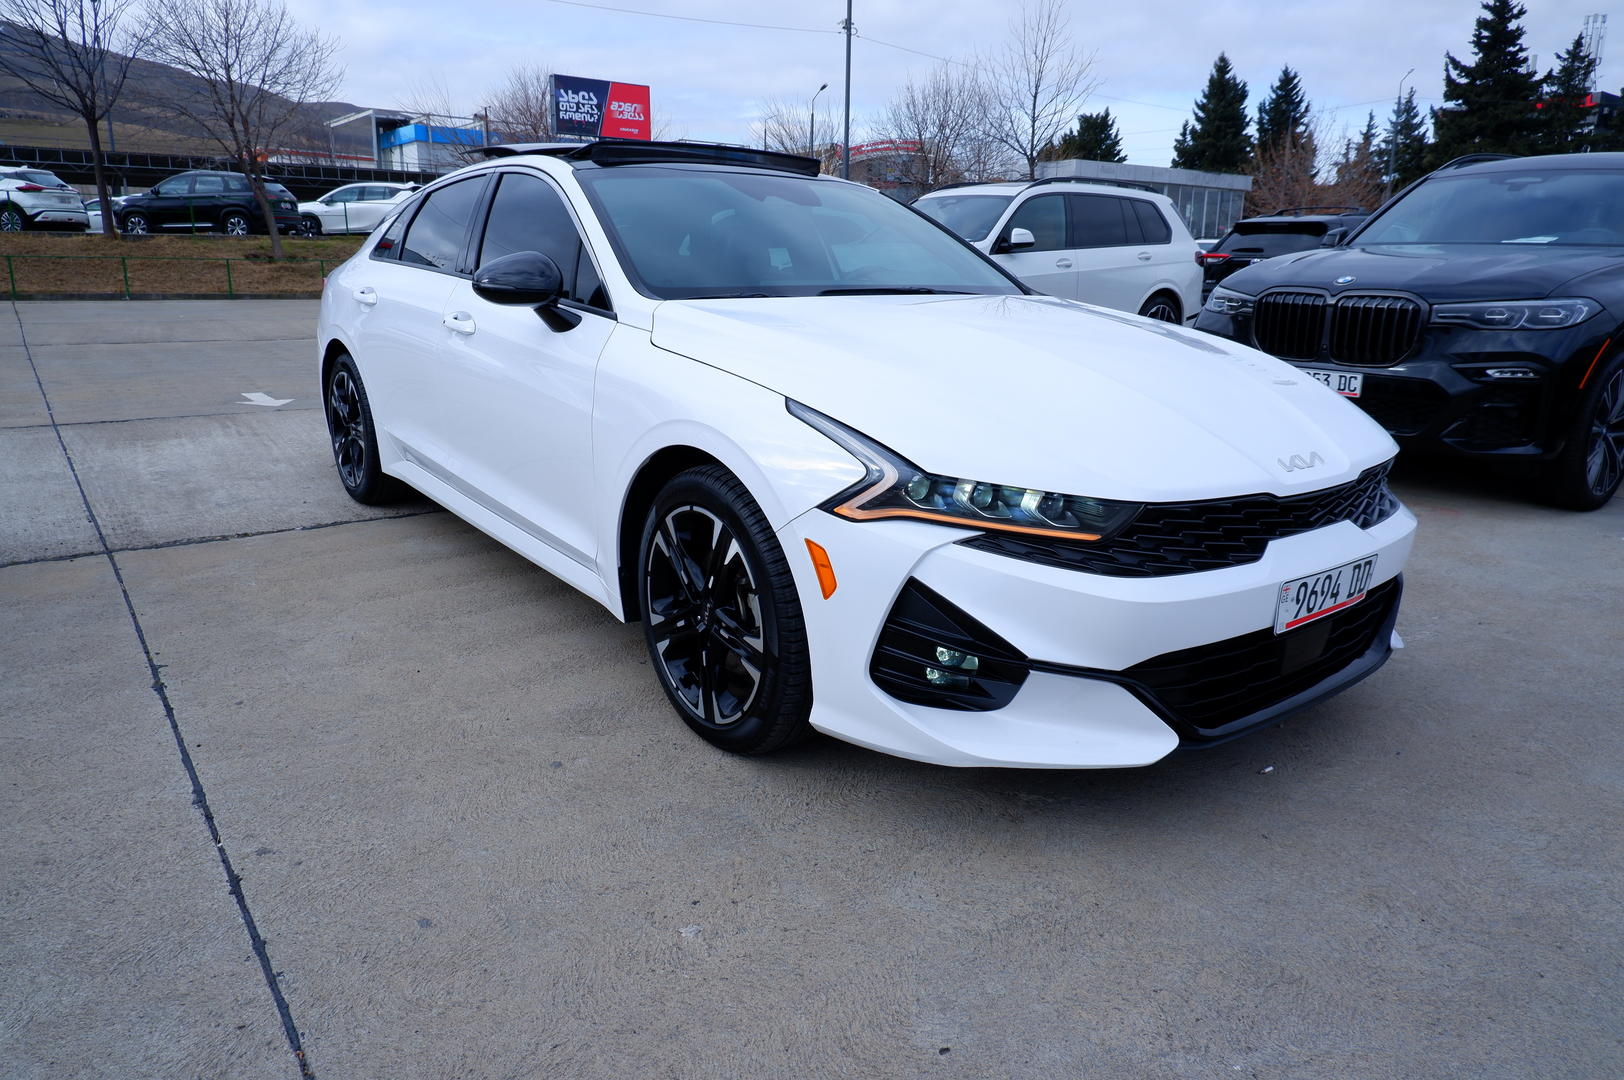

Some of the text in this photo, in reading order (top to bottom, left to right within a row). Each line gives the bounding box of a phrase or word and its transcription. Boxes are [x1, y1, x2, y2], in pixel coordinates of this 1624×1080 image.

[559, 89, 598, 105] ახლა
[559, 101, 576, 112] თუ
[1337, 374, 1358, 392] DC
[1293, 559, 1373, 619] 9694 DD
